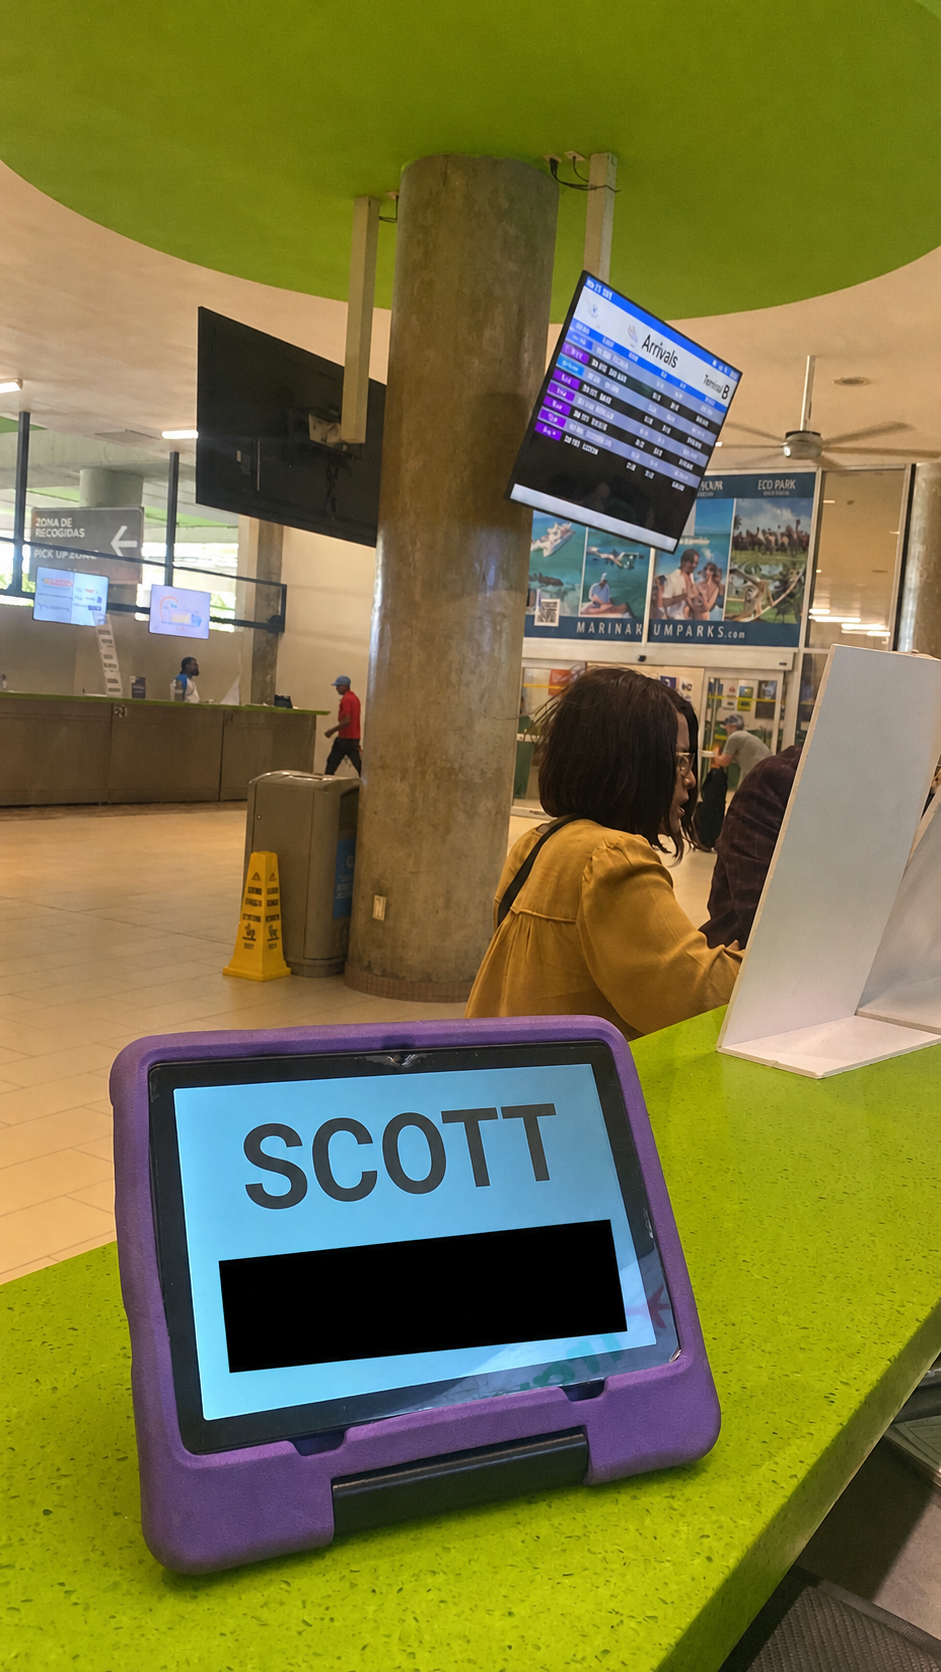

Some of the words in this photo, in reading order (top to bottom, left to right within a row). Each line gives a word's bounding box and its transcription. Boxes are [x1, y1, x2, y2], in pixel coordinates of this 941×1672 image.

[641, 334, 678, 368] Arrivals
[703, 374, 723, 393] Terminal
[721, 384, 730, 400] B
[757, 479, 773, 491] ECO
[774, 478, 797, 490] PARK
[35, 517, 60, 527] ZONA
[60, 517, 73, 527] DE
[35, 528, 85, 538] RECOGIDAS
[34, 549, 54, 559] PICK
[55, 550, 69, 560] UP
[243, 1102, 557, 1210] SCOTT
